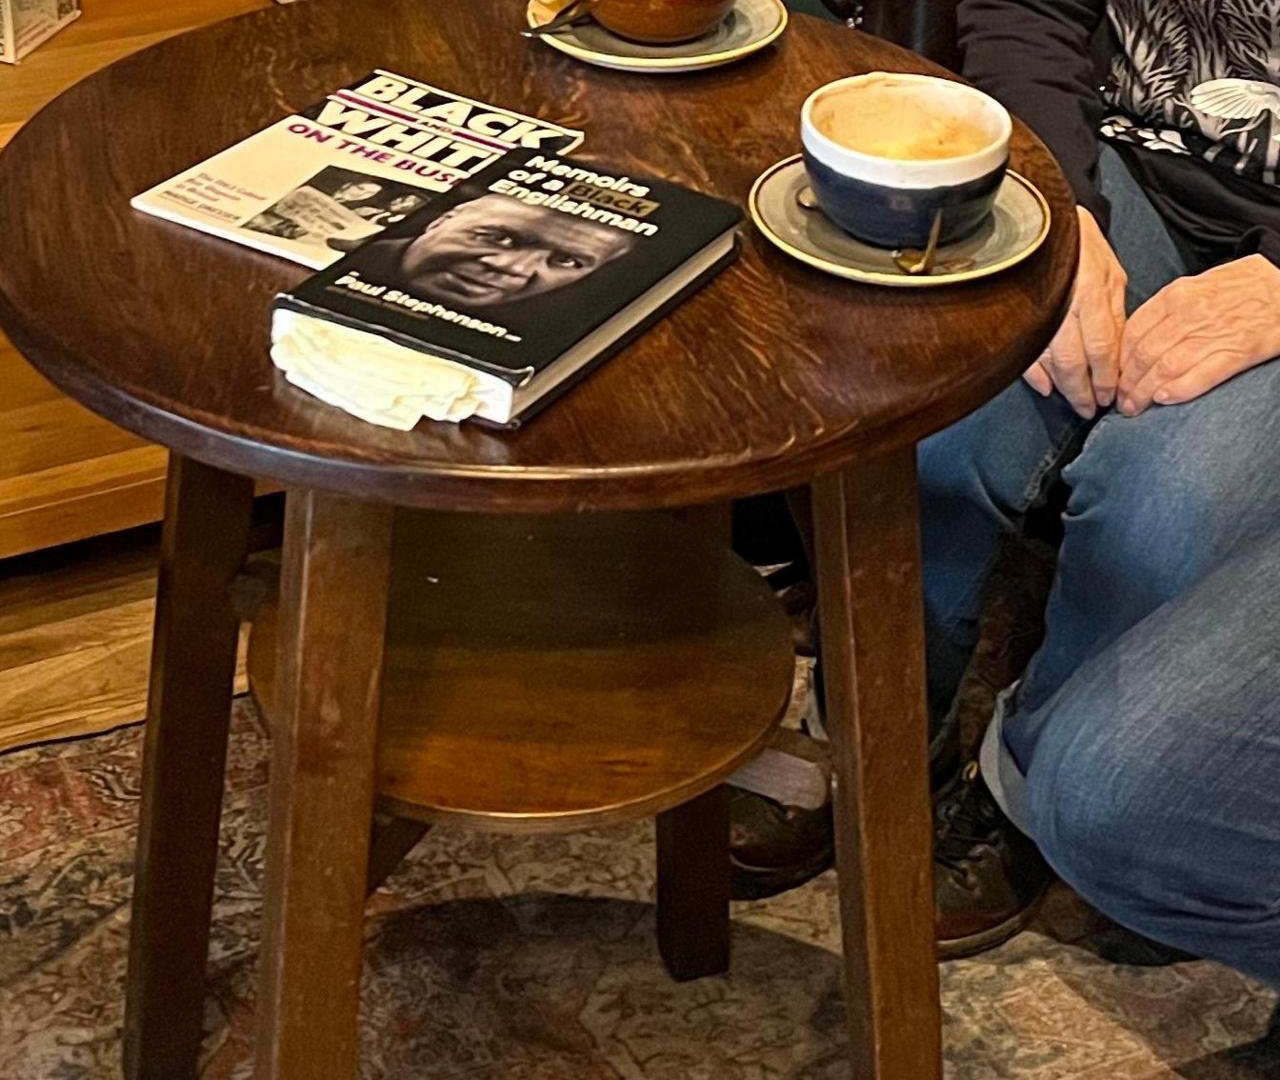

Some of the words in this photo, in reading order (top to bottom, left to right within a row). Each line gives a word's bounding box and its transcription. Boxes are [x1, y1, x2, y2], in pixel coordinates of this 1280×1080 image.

[316, 98, 500, 169] WHIT
[351, 75, 566, 150] BLACK
[417, 121, 454, 134] AND
[288, 123, 333, 143] ON
[337, 137, 389, 164] THE
[508, 169, 548, 184] of
[541, 179, 565, 191] a
[569, 183, 651, 215] Black
[525, 155, 651, 198] Memoirs
[488, 178, 659, 236] Englishman
[334, 271, 387, 297] Paul
[382, 289, 508, 338] Stephenson
